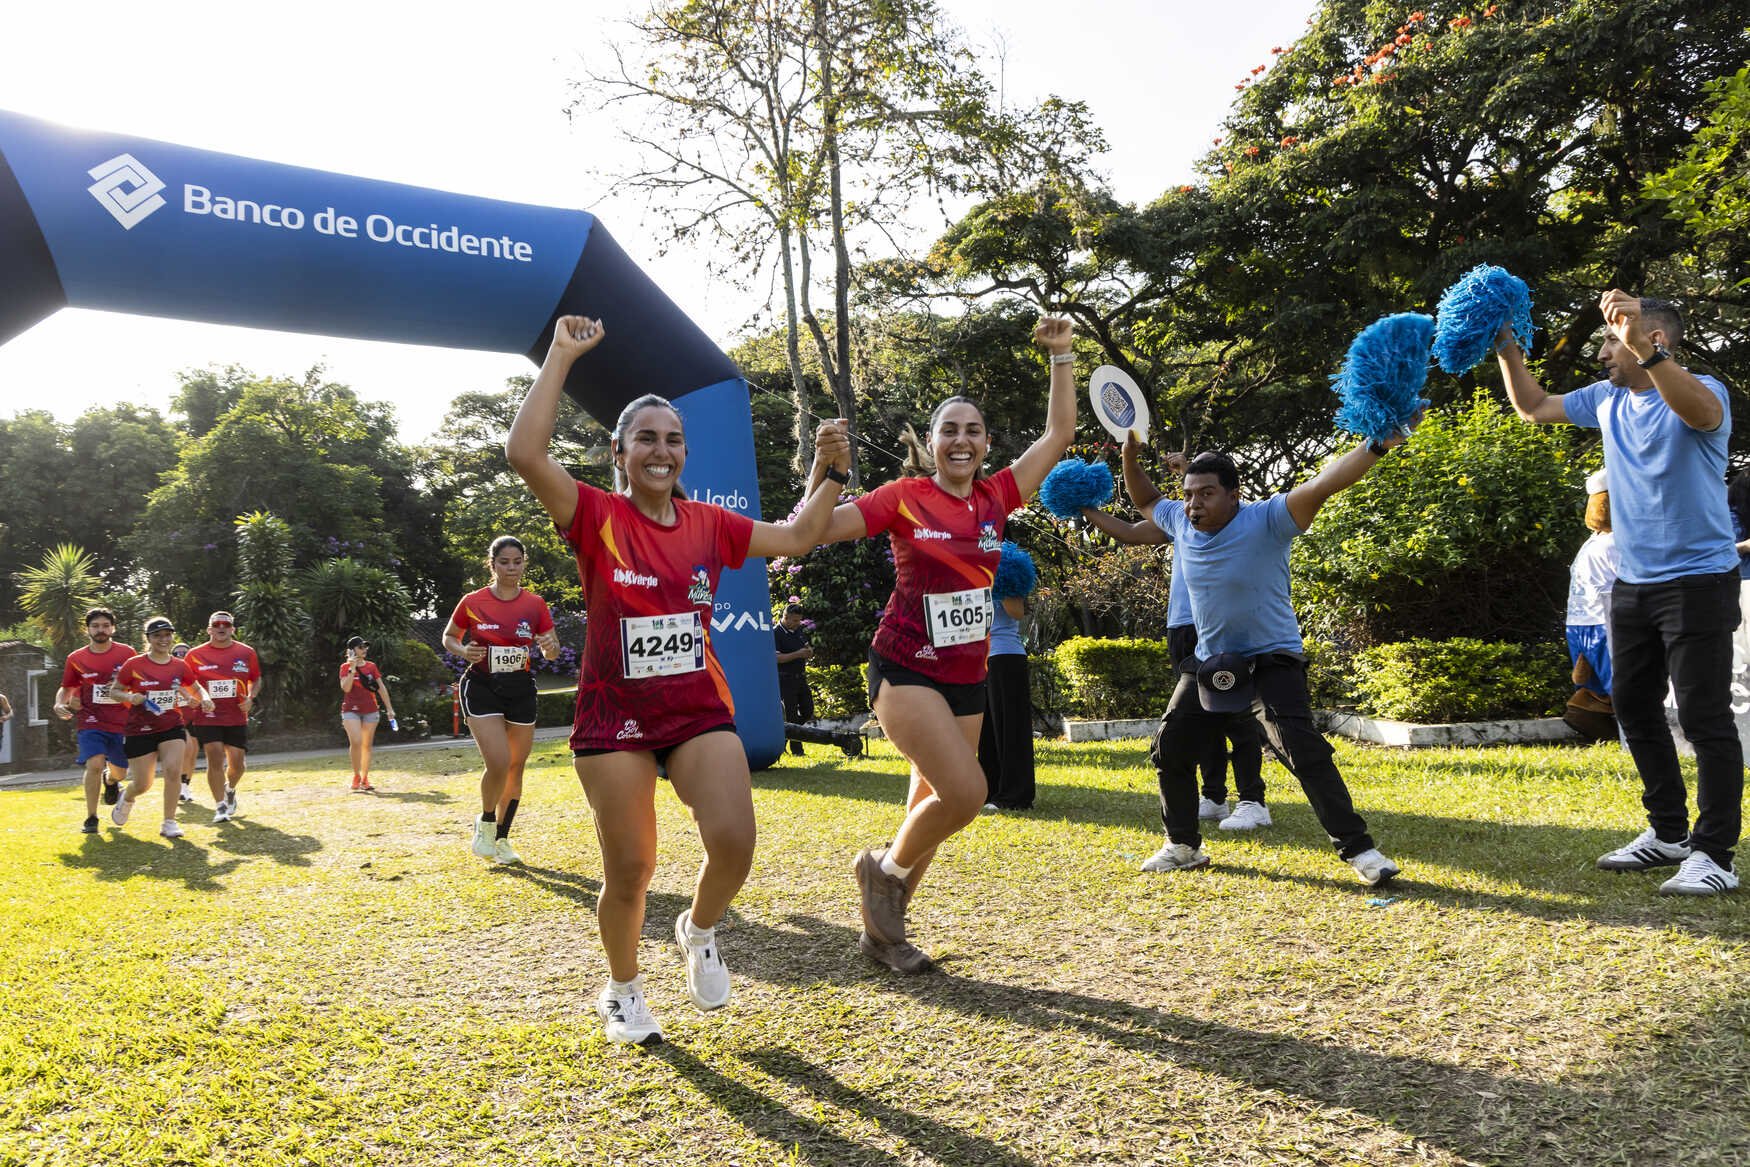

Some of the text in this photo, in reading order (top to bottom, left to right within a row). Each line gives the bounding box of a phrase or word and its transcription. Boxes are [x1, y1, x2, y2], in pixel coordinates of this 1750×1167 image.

[183, 183, 533, 262] Banco de Occidente
[711, 611, 770, 633] VAL
[937, 605, 984, 628] 1605
[629, 632, 694, 658] 4249
[495, 653, 522, 665] 1906
[212, 685, 229, 693] 366
